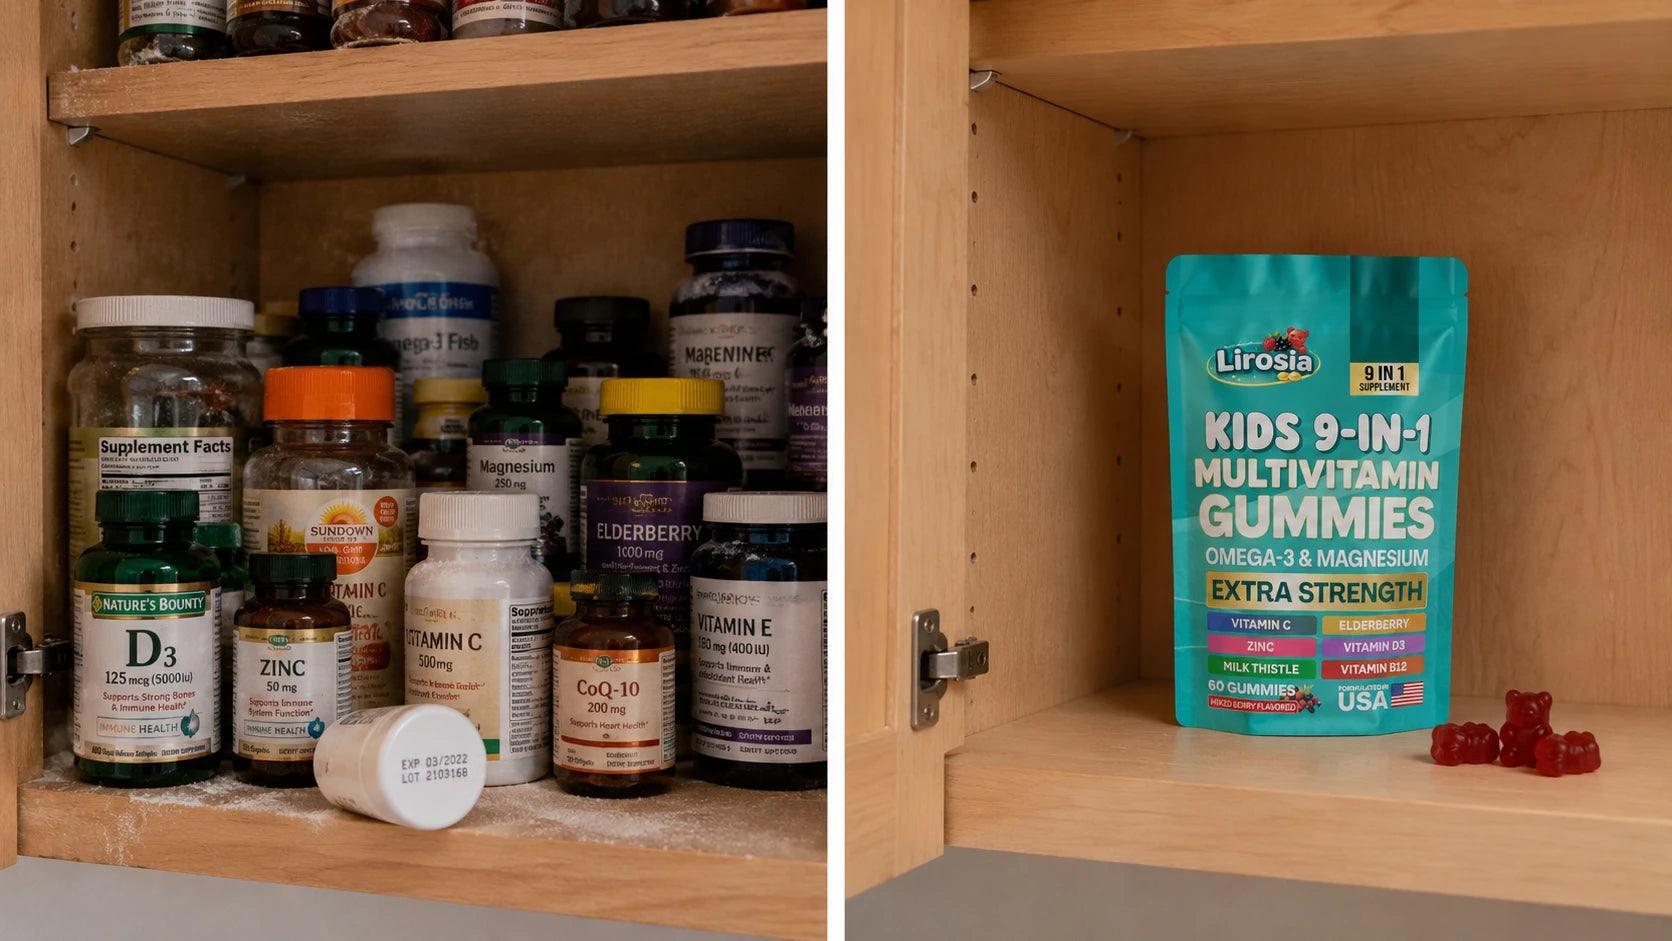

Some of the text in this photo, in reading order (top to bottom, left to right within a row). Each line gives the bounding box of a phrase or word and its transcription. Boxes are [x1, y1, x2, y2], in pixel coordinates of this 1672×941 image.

[1216, 347, 1312, 373] Lirosia
[1364, 365, 1405, 381] 9 IN 1
[1359, 382, 1410, 392] SUPPLEMENT
[1205, 411, 1431, 453] KIDS 9-IN-1
[101, 439, 231, 456] Supplement Facts
[480, 459, 555, 475] Magnesium
[1194, 458, 1439, 490] MULTIVITAMIN
[1198, 493, 1435, 540] GUMMIES
[310, 526, 374, 537] SUNDOWN
[597, 522, 702, 541] ELDERBERRY
[1205, 547, 1429, 568] OMEGA-3 & MAGNESIUM
[378, 582, 387, 597] C
[1212, 579, 1422, 604] EXTRA STRENGTH
[103, 596, 204, 611] NATURE'S BOUNTY
[698, 613, 773, 637] VITAMIN E
[1231, 618, 1291, 630] VITAMIN C
[1339, 618, 1410, 631] ELDERBERRY
[468, 633, 482, 651] C
[712, 643, 726, 655] mg
[728, 641, 753, 655] (400
[1247, 641, 1274, 652] ZINC
[1343, 640, 1406, 653] VITAMIN D3
[260, 659, 305, 677] ZINC
[1223, 661, 1299, 674] MILK THISTLE
[1340, 662, 1407, 675] VITAMIN B12
[105, 671, 126, 685] 125
[128, 674, 149, 687] mcg
[266, 681, 297, 693] 50 mg
[142, 692, 170, 702] Strong
[172, 690, 195, 700] Bones
[577, 679, 640, 699] CoQ-10
[1208, 679, 1297, 697] 60 GUMMIES
[587, 702, 626, 715] 200 mg
[1338, 691, 1388, 711] USA
[139, 723, 178, 734] HEALTH
[402, 754, 468, 770] EXP 03/2022
[402, 767, 468, 784] LOT 2103168
